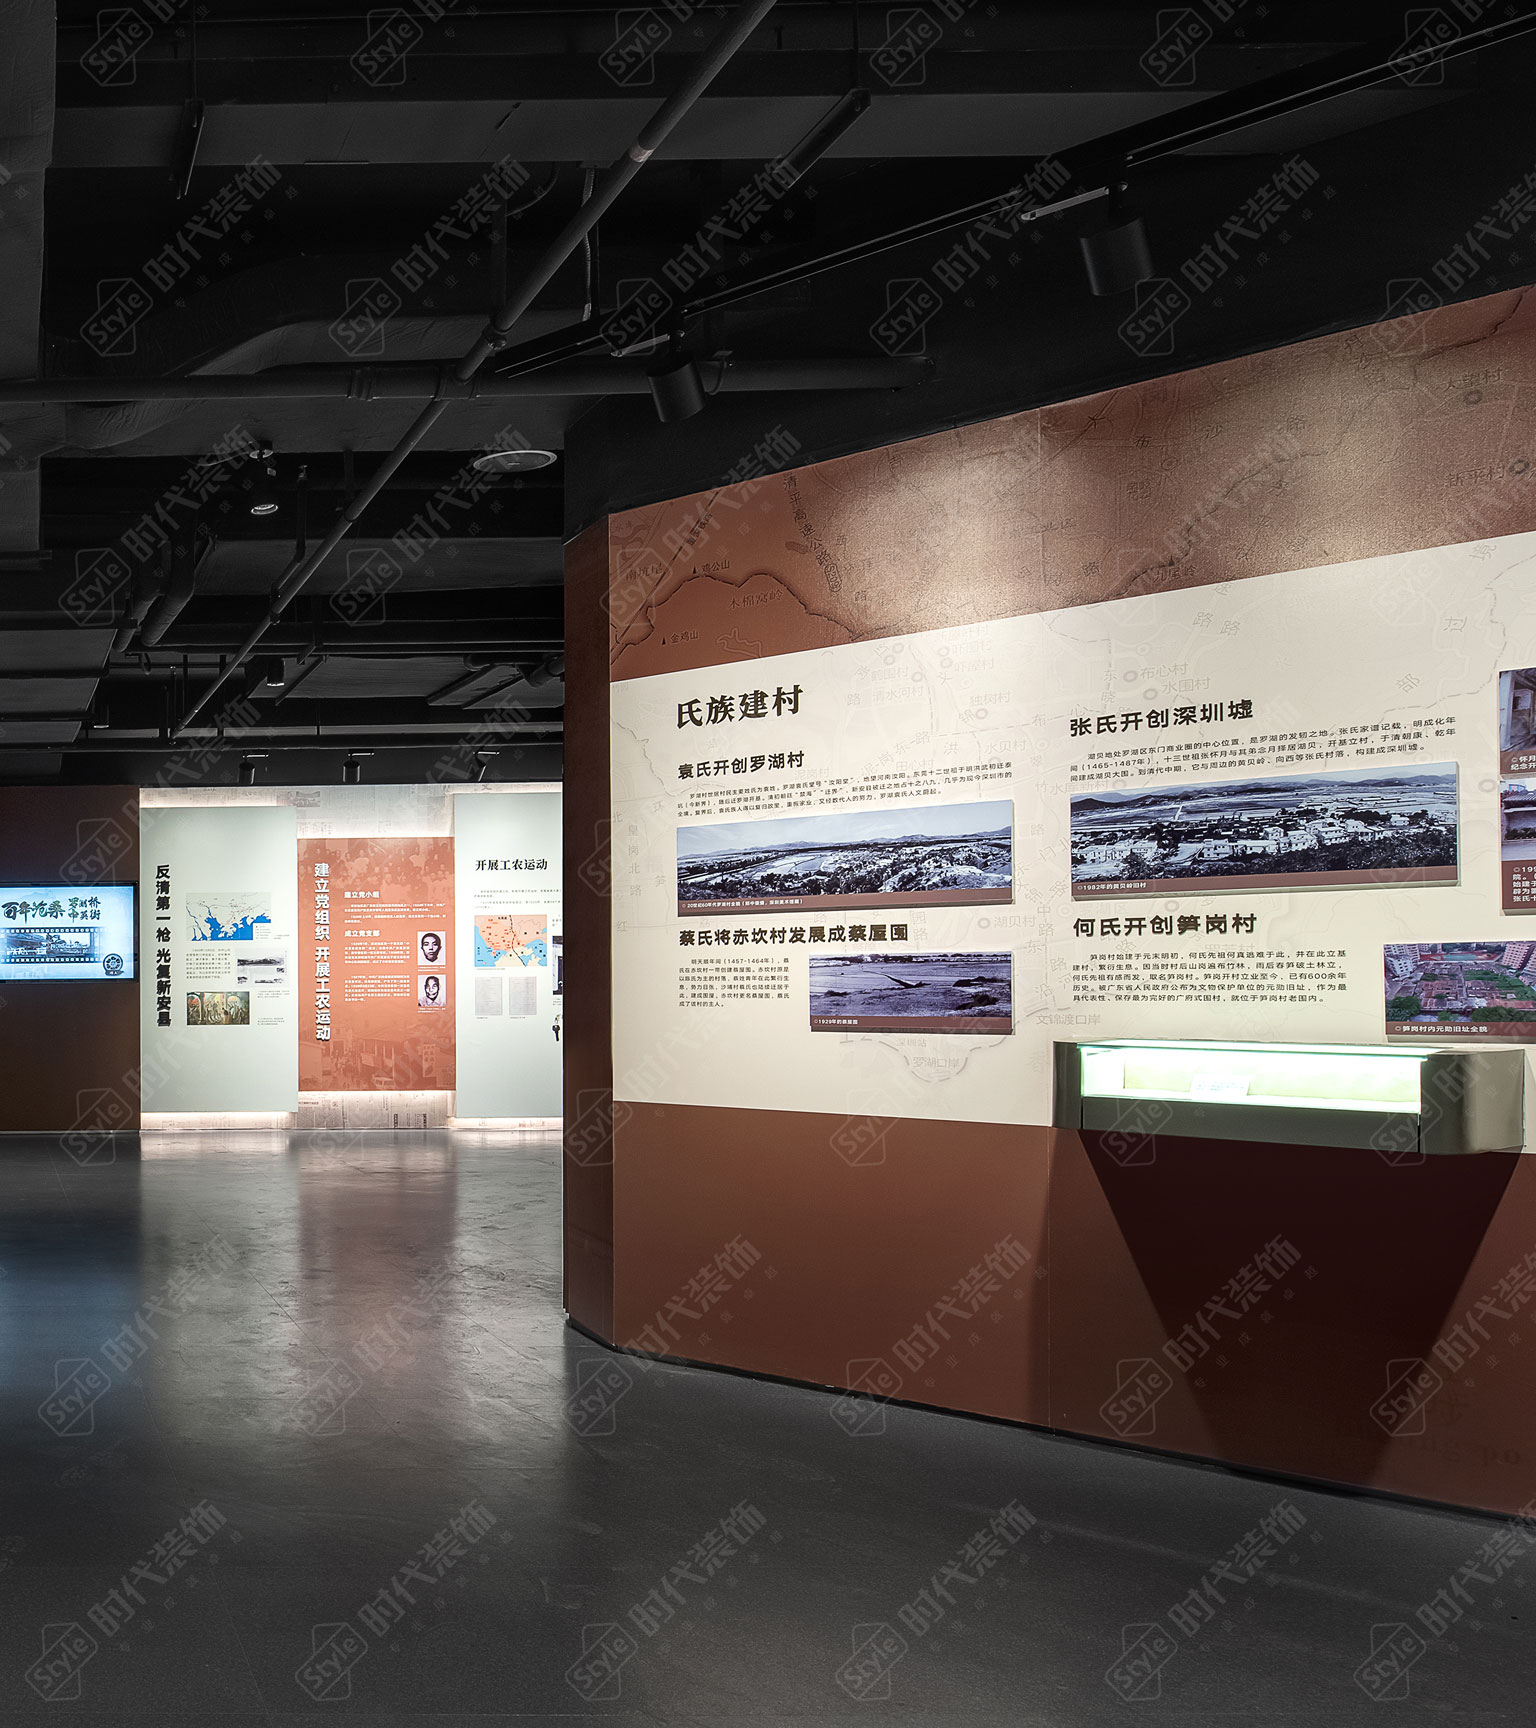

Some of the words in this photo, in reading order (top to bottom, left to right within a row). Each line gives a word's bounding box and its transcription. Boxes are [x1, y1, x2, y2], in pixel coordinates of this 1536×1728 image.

[676, 684, 804, 730] 氏族建村
[1070, 699, 1254, 738] 张氏开创深圳墟
[678, 750, 805, 780] 袁氏开创罗湖村
[475, 858, 548, 871] 开展工农运动
[155, 864, 171, 943] 反清第一枪
[314, 862, 330, 941] 建立党组织
[679, 923, 909, 947] 蔡氏将赤坎村发展成蔡屋围
[1073, 913, 1257, 937] 何氏开创笋岗村
[156, 948, 172, 1027] 光复新安县
[315, 946, 331, 1041] 开展工农运动
